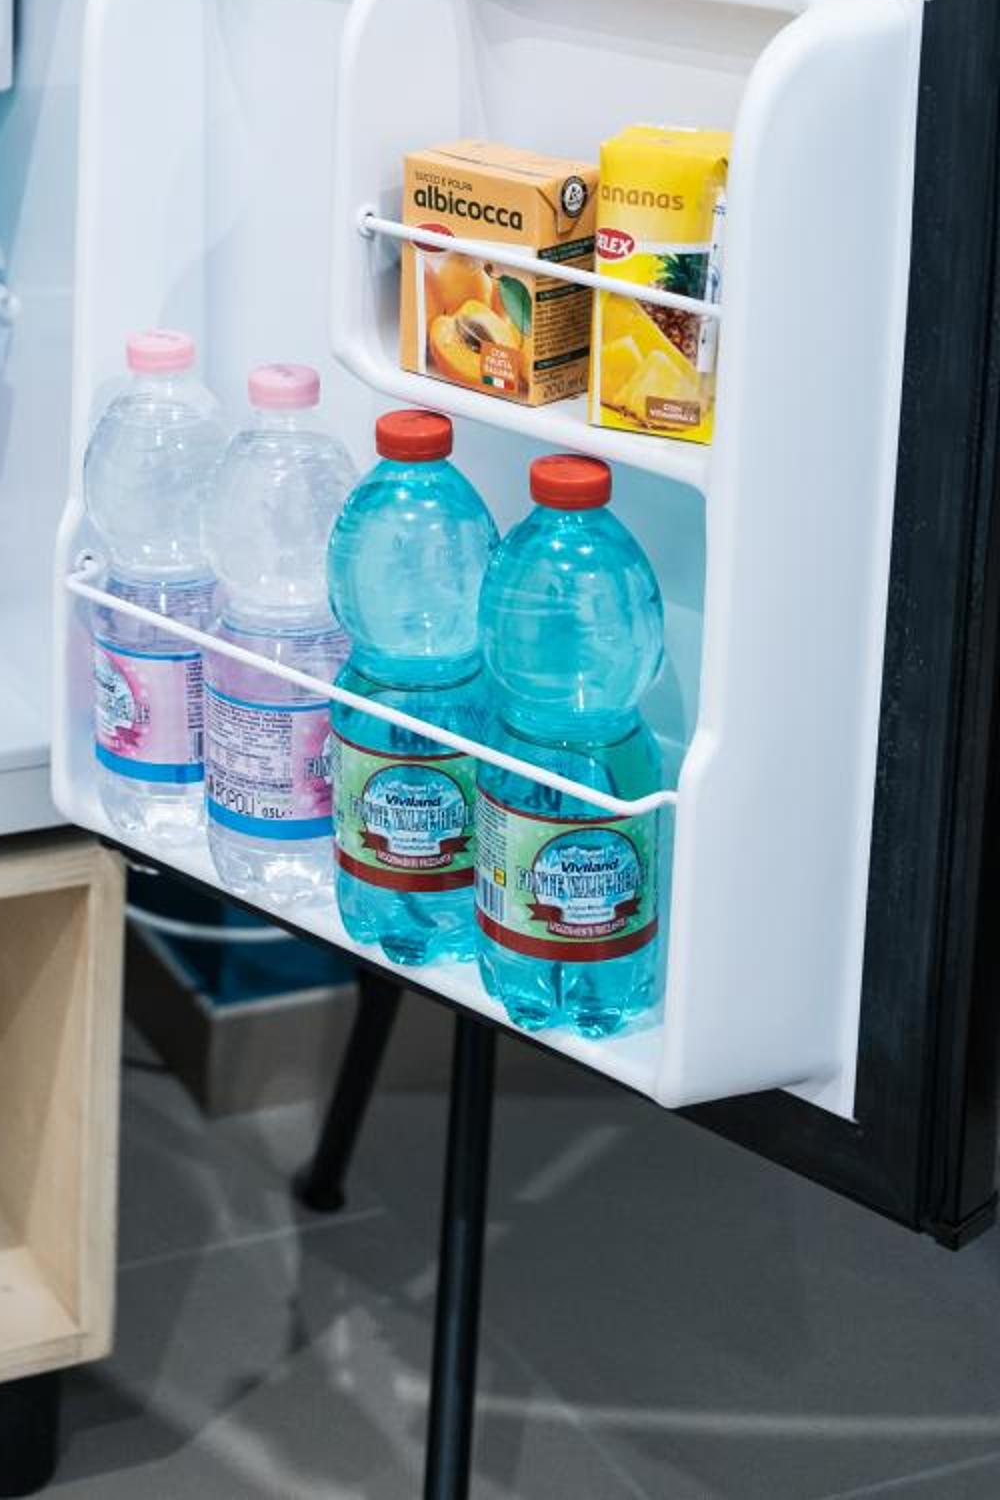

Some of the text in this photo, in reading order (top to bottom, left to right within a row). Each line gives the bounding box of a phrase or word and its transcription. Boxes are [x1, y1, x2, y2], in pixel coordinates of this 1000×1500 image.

[413, 184, 522, 231] albicocca
[600, 184, 685, 211] ananas
[385, 794, 442, 806] Viviland
[561, 858, 619, 872] Viviland
